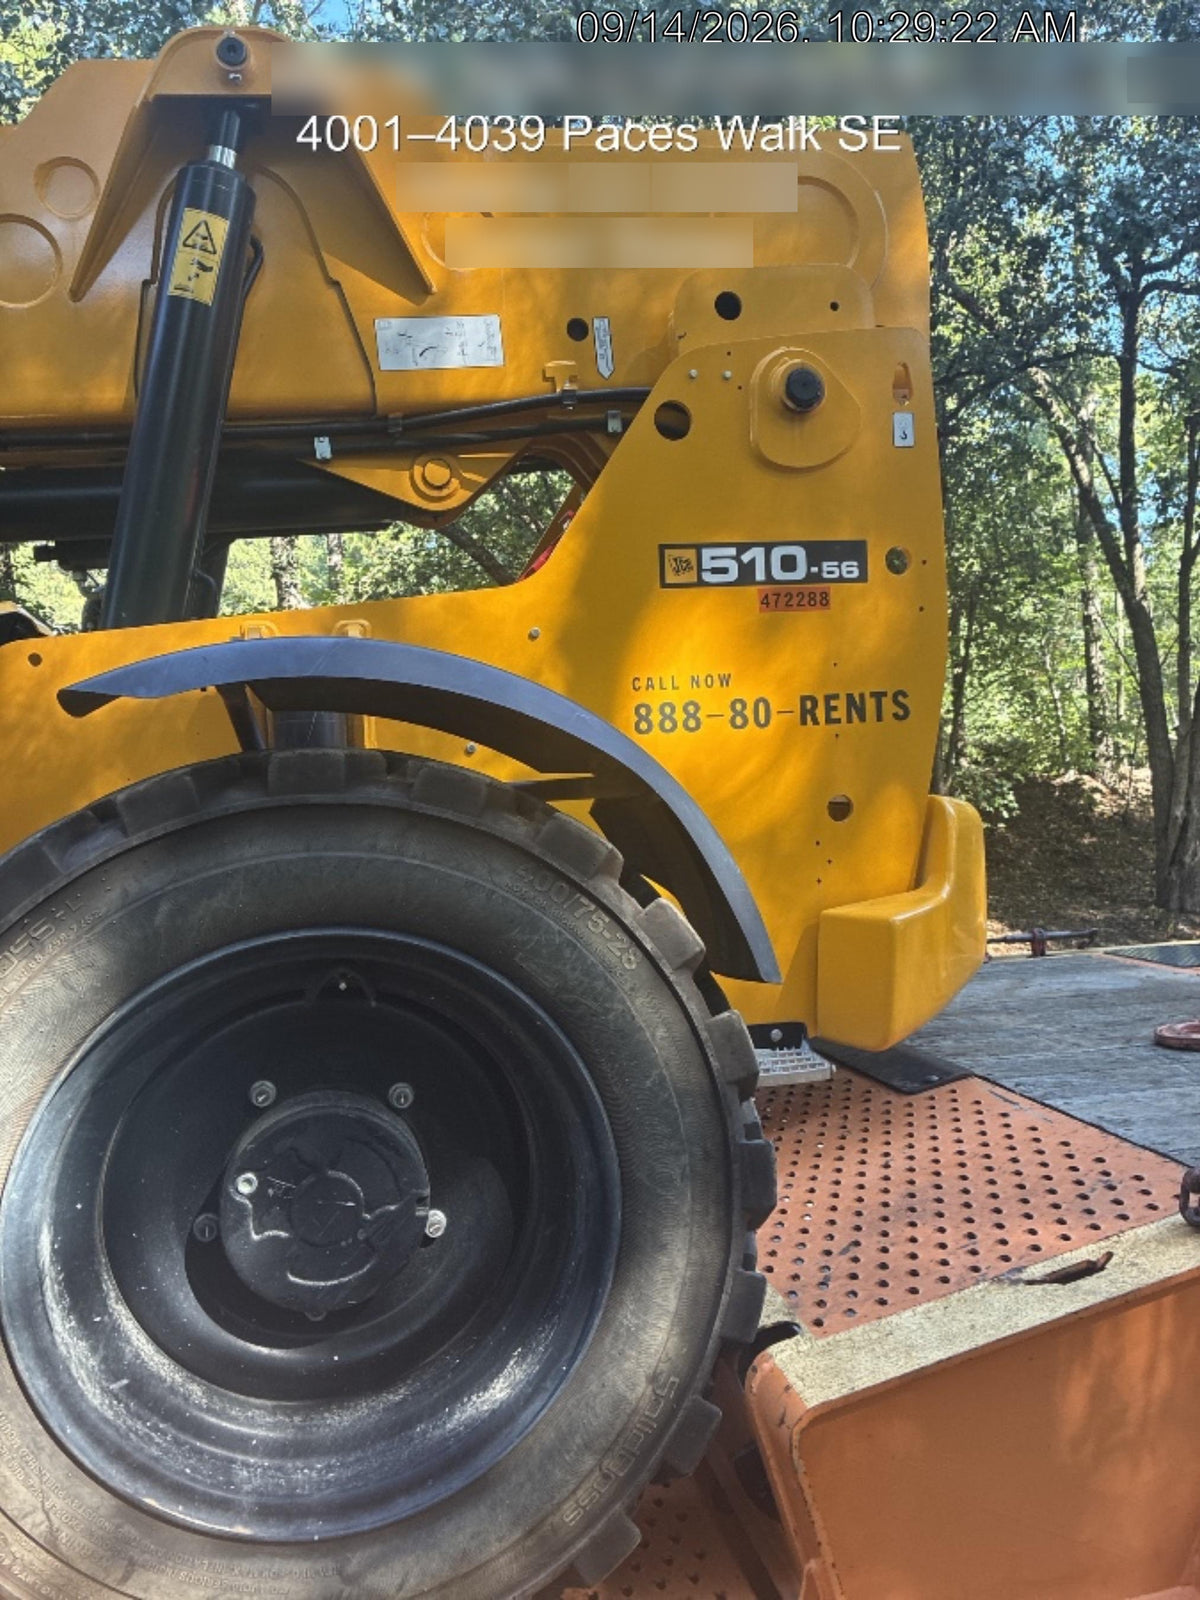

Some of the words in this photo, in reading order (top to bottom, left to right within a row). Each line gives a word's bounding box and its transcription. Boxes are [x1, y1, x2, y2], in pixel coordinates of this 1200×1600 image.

[701, 545, 859, 583] 510-56
[760, 591, 830, 608] 472288
[632, 677, 679, 691] CALL
[691, 673, 731, 688] NOW
